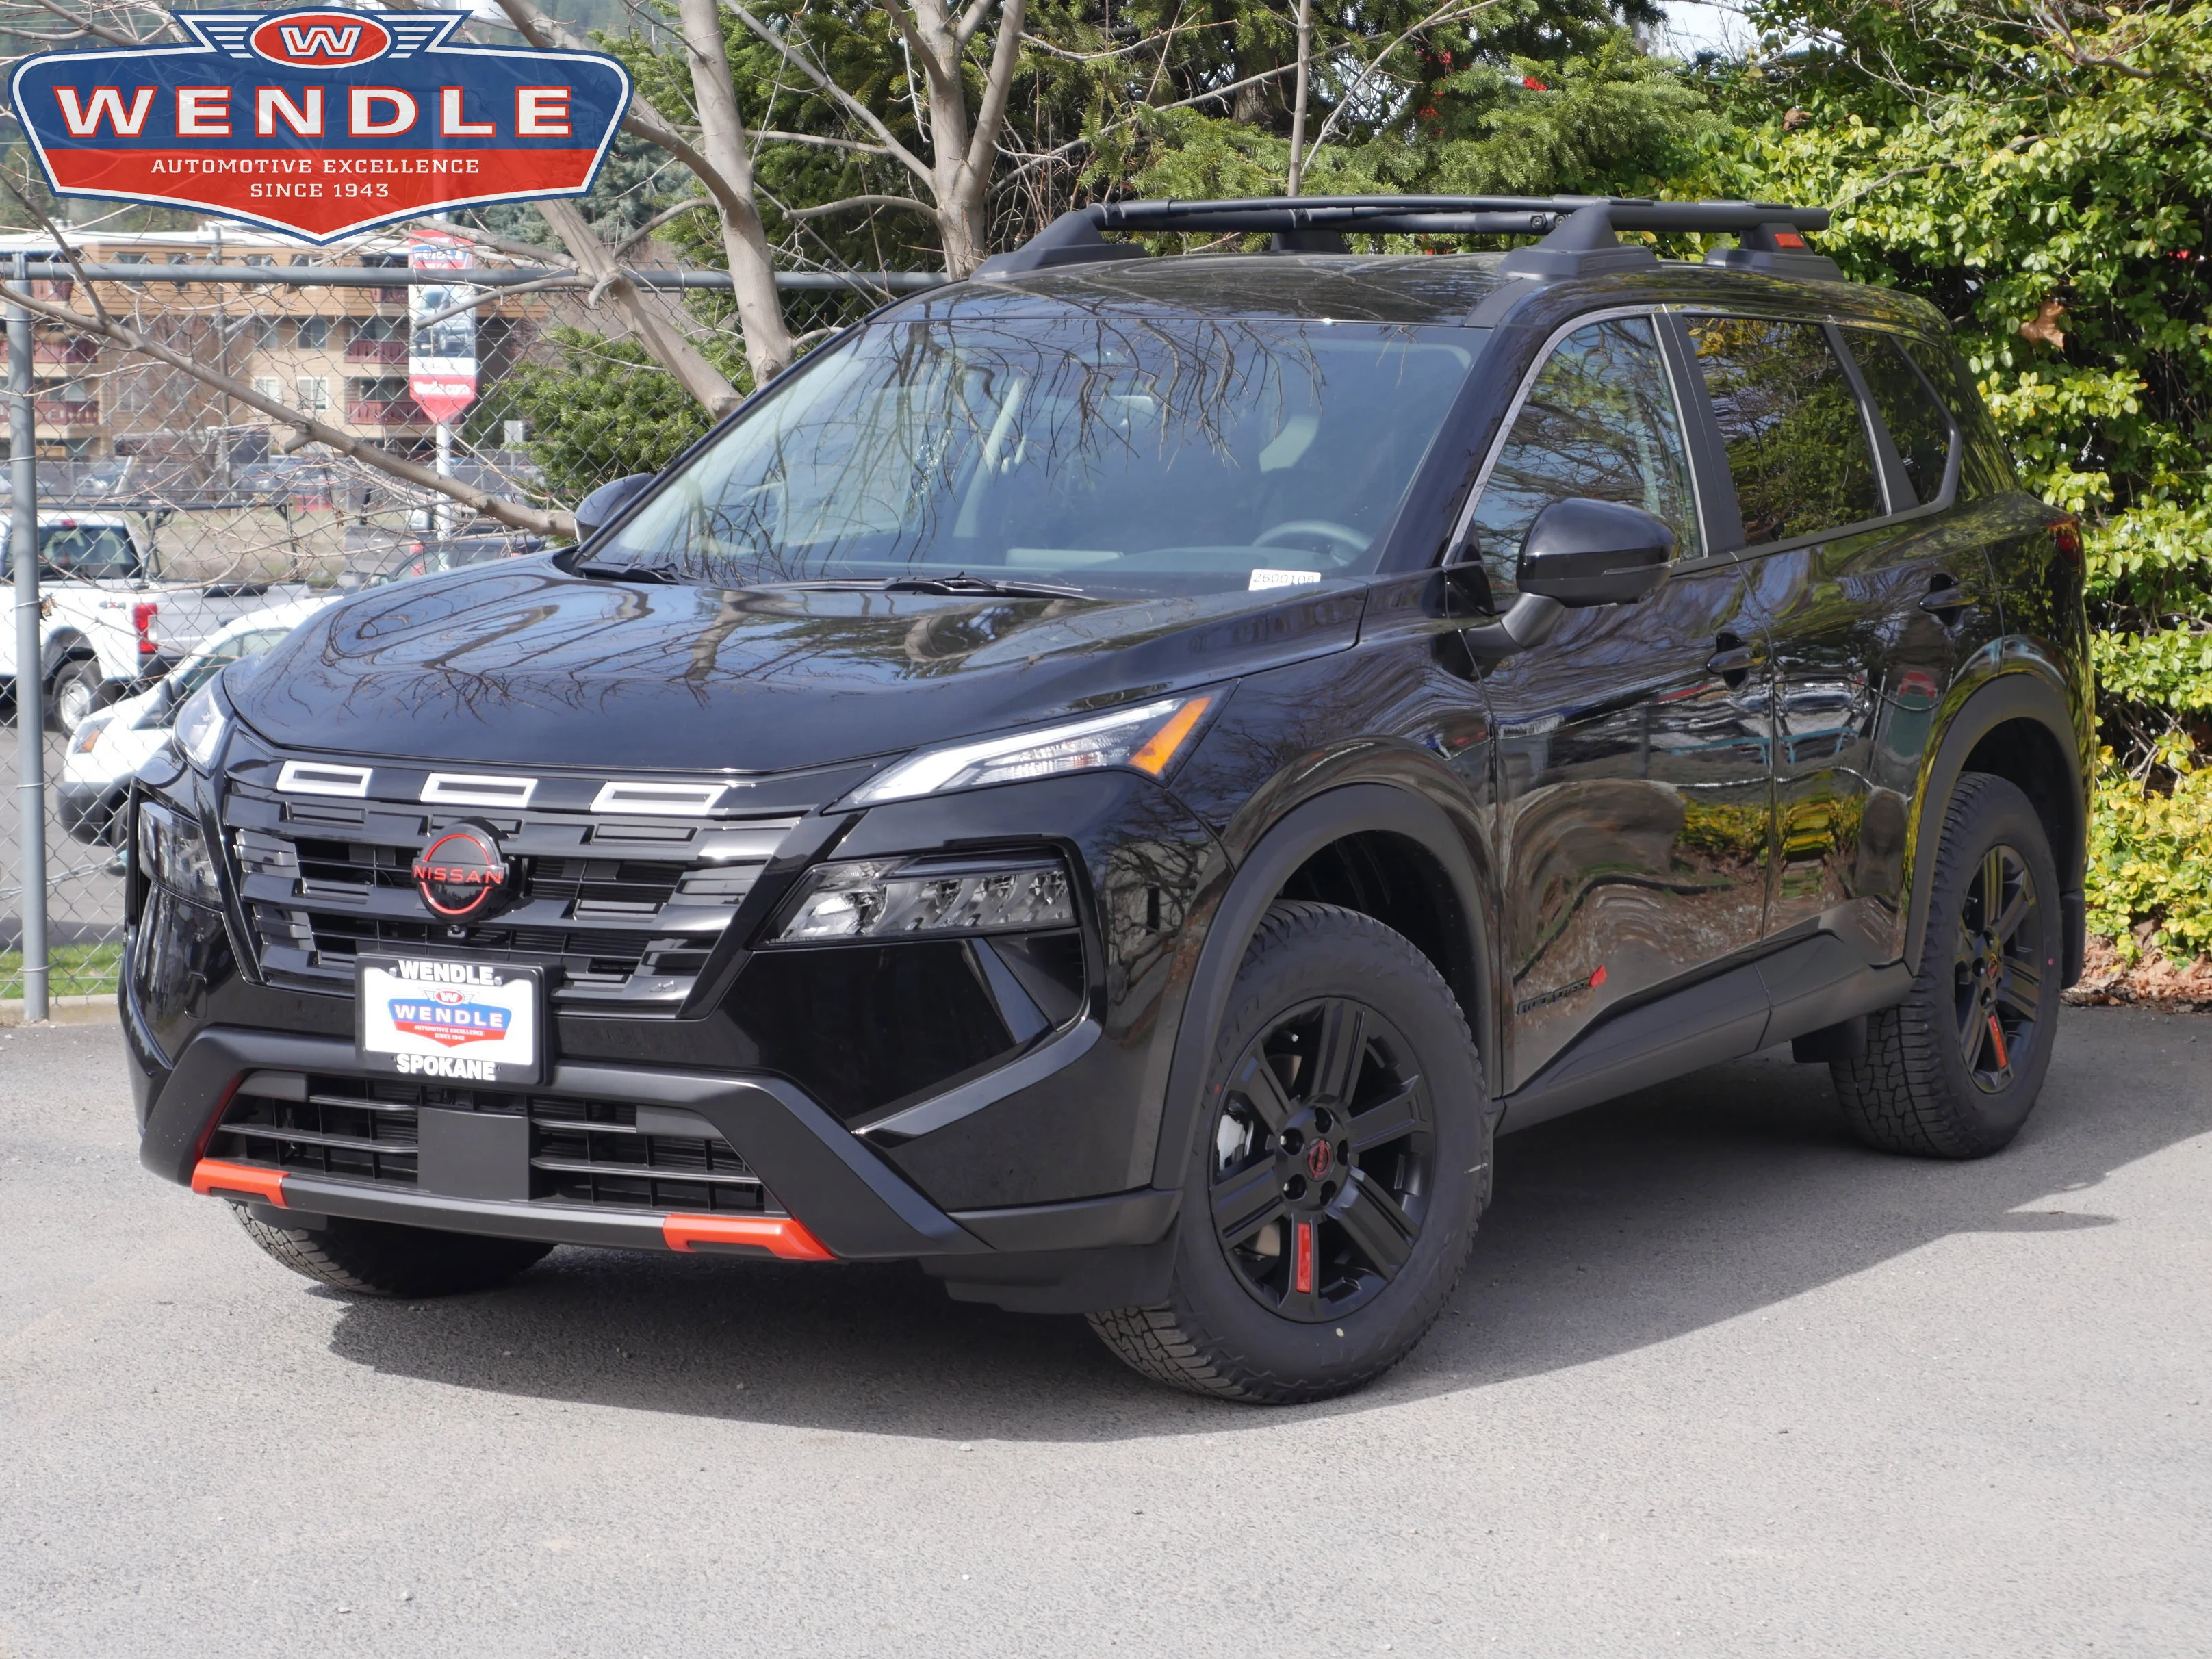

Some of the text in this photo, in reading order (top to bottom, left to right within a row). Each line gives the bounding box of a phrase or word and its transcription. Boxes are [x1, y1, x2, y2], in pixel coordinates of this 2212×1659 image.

[413, 864, 503, 884] NISSAN
[398, 960, 495, 986] WENDLE
[394, 1004, 503, 1027] WENDLE
[450, 1028, 485, 1036] EXCELLENCE
[396, 1053, 496, 1081] SPOKANE
